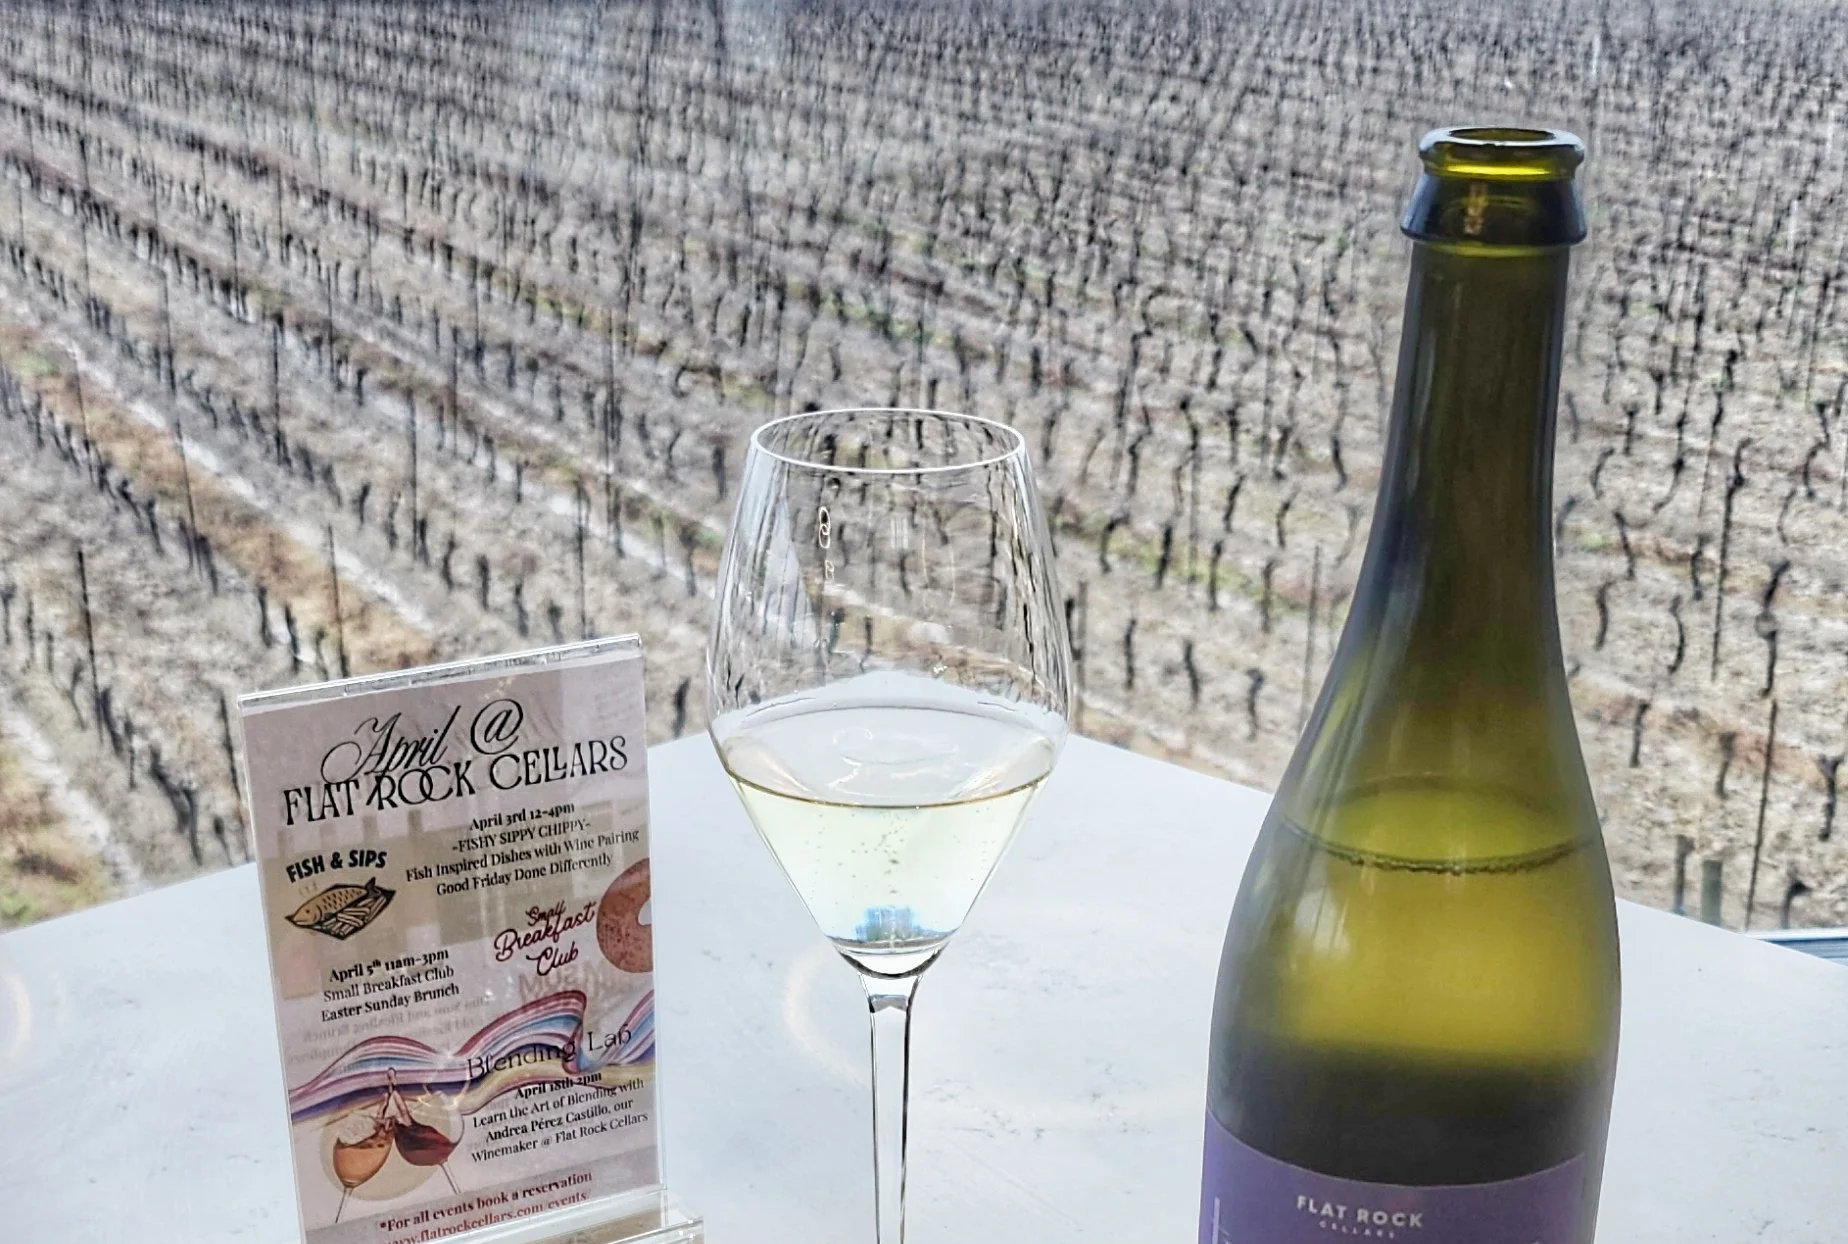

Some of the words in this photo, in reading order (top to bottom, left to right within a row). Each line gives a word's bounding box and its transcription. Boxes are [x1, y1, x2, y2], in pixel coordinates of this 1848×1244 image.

[320, 705, 461, 806] April
[470, 699, 523, 755] @
[283, 779, 360, 826] FLAT
[374, 760, 477, 810] ROCK
[489, 735, 628, 790] CELLARS
[452, 834, 497, 853] -FISHY
[500, 826, 536, 846] SIPPY
[538, 819, 590, 838] CHIPPY-
[469, 813, 502, 831] April
[507, 808, 526, 824] 3rd
[530, 803, 575, 821] 12-4pm
[286, 855, 325, 883] FISH
[330, 851, 343, 869] &
[348, 850, 387, 868] SIPS
[406, 866, 433, 882] Fish
[436, 853, 488, 877] Inspired
[491, 847, 532, 866] Dishes
[534, 842, 562, 858] with
[564, 838, 595, 853] Wine
[598, 829, 639, 849] Pairing
[436, 879, 469, 896] Good
[473, 870, 513, 890] Friday
[515, 866, 547, 882] Done
[549, 852, 614, 876] Differently
[494, 901, 597, 962] Breakfast
[525, 900, 567, 926] Small
[329, 963, 363, 983] April
[366, 958, 382, 976] 5th
[384, 949, 449, 972] 11am-3pm
[526, 941, 579, 976] Club
[321, 1004, 363, 1022] Easter
[364, 994, 412, 1014] Sunday
[414, 983, 460, 1002] Brunch
[323, 984, 359, 1002] Small
[363, 971, 421, 995] Breakfast
[424, 965, 455, 982] Club
[467, 1040, 576, 1078] Blending
[587, 1023, 632, 1052] Lab
[473, 1110, 508, 1129] Learn
[509, 1106, 530, 1120] the
[530, 1101, 550, 1116] Art
[552, 1095, 565, 1109] of
[567, 1086, 617, 1106] Blending
[619, 1077, 645, 1094] with
[515, 1083, 547, 1100] April
[549, 1076, 574, 1092] 18th
[577, 1071, 602, 1087] 2pm
[471, 1137, 539, 1163] Winemaker
[540, 1137, 551, 1147] @
[555, 1130, 577, 1145] Flat
[580, 1122, 608, 1138] Rock
[609, 1112, 649, 1131] Cellars
[486, 1124, 528, 1143] Andrea
[531, 1115, 563, 1133] Pérez
[565, 1104, 611, 1123] Castillo,
[613, 1099, 634, 1112] our
[413, 1210, 429, 1224] all
[433, 1202, 474, 1220] events
[476, 1191, 509, 1210] book
[512, 1190, 519, 1201] a
[522, 1172, 593, 1199] reservation
[1296, 1195, 1348, 1220] FLAT
[1357, 1208, 1424, 1228] ROCK
[1319, 1220, 1396, 1239] CELLARS
